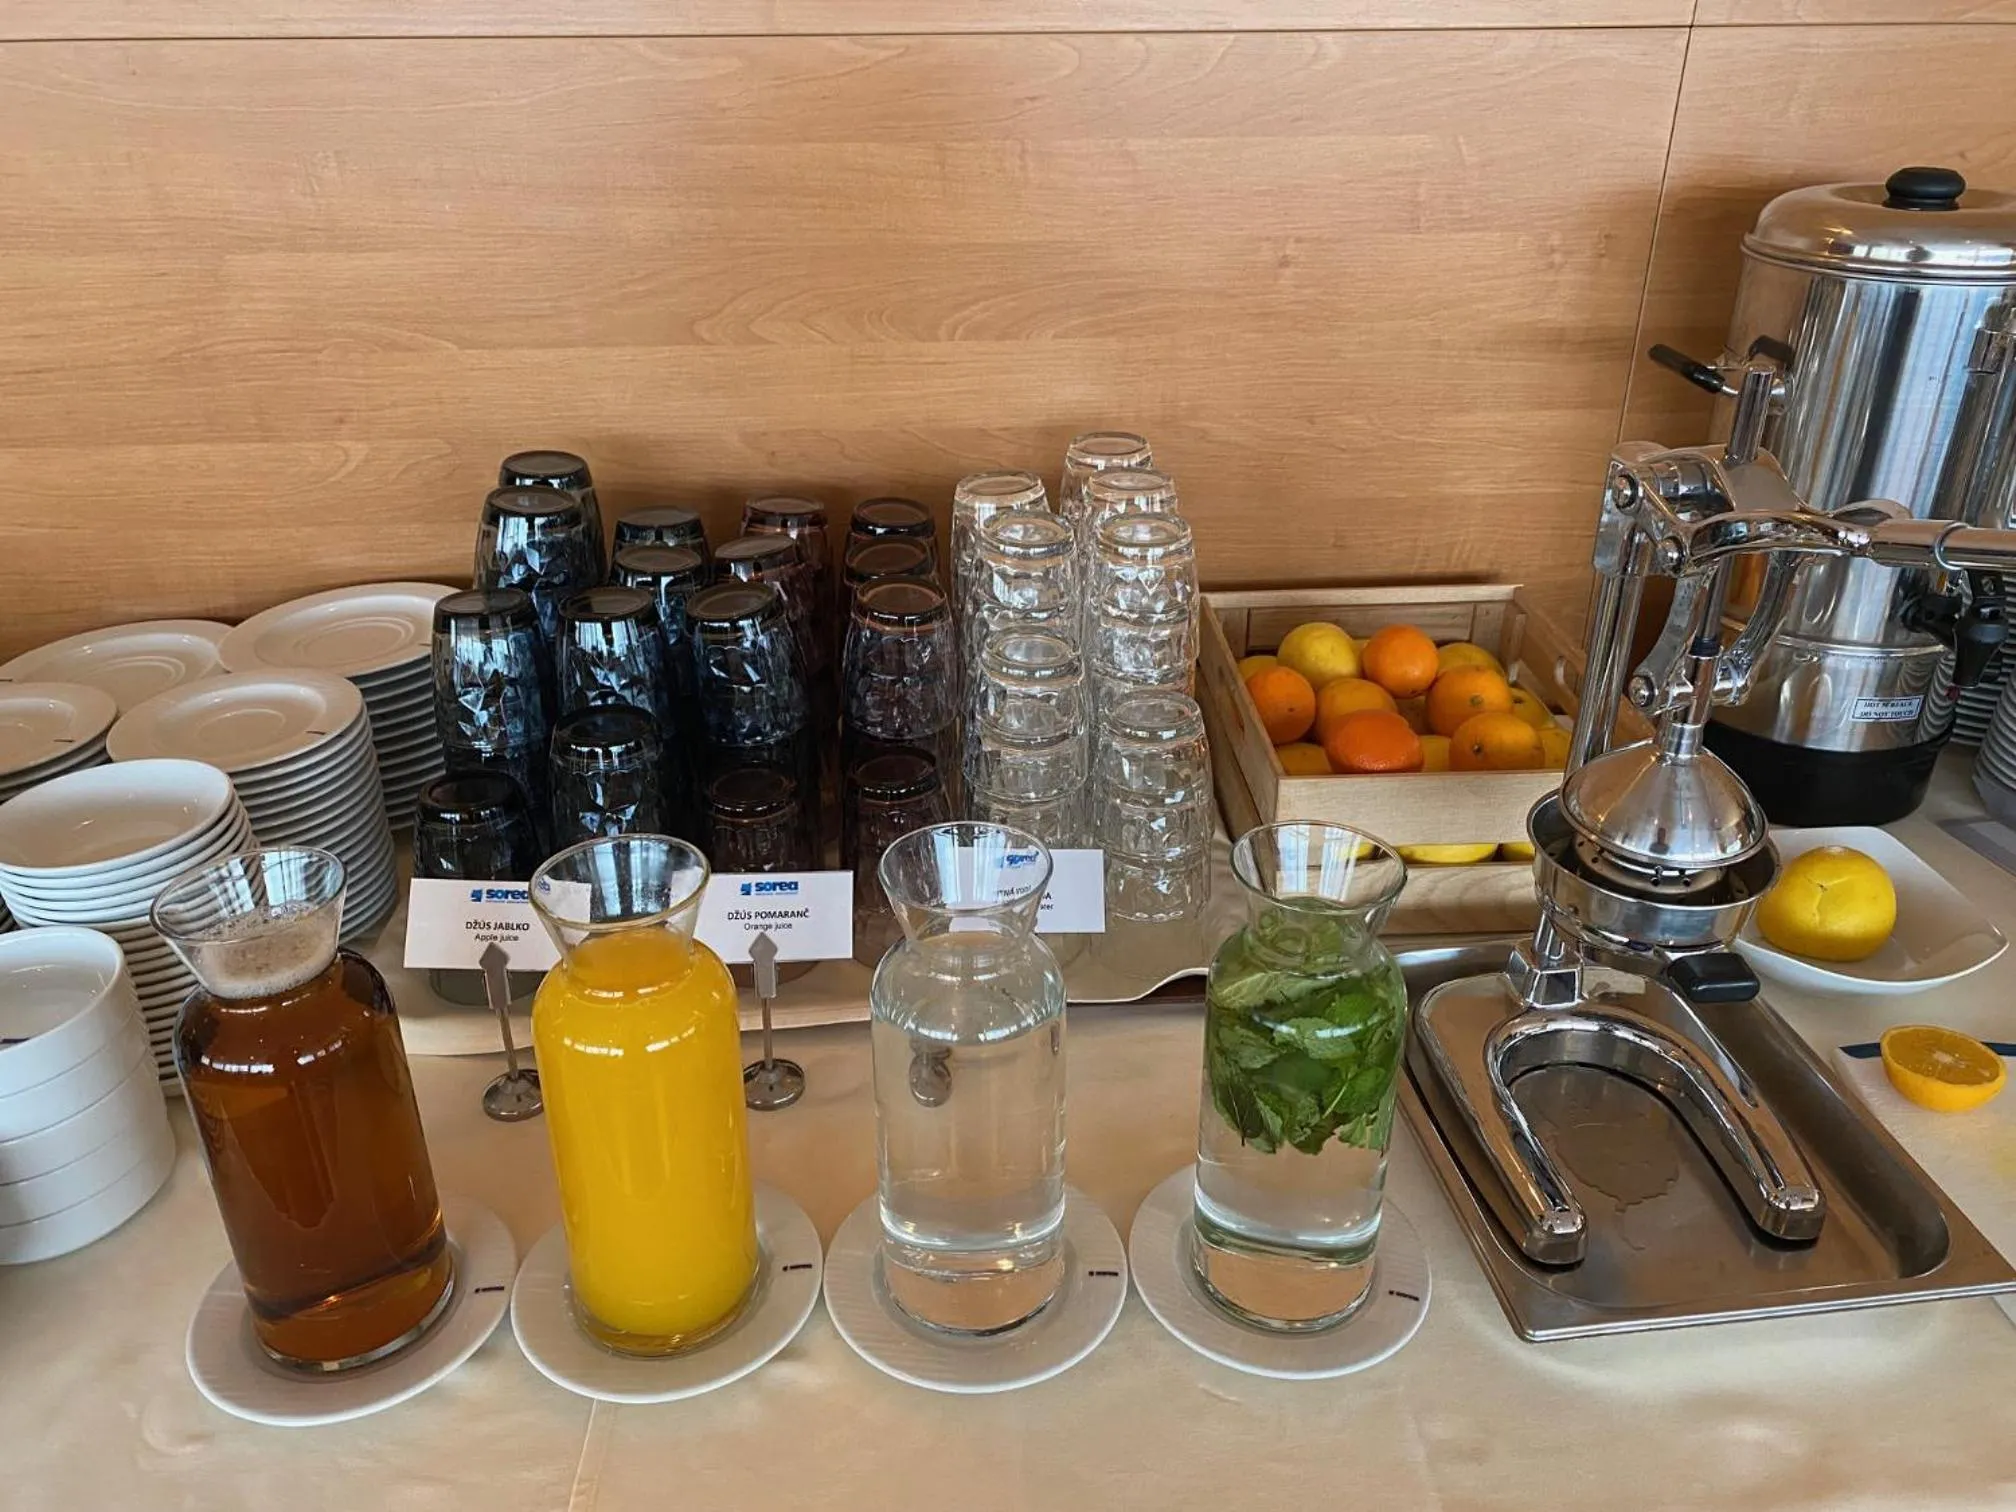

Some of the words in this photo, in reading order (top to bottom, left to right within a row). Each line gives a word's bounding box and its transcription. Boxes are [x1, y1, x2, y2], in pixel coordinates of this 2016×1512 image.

[755, 881, 799, 892] sorea
[727, 908, 752, 921] DŽÚS
[754, 907, 810, 920] POMARANČ
[465, 919, 492, 931] DŽÚS
[493, 921, 530, 931] JABLKO
[744, 922, 773, 932] Orange
[775, 922, 793, 932] juice
[475, 933, 499, 942] Apple
[500, 933, 519, 943] juice
